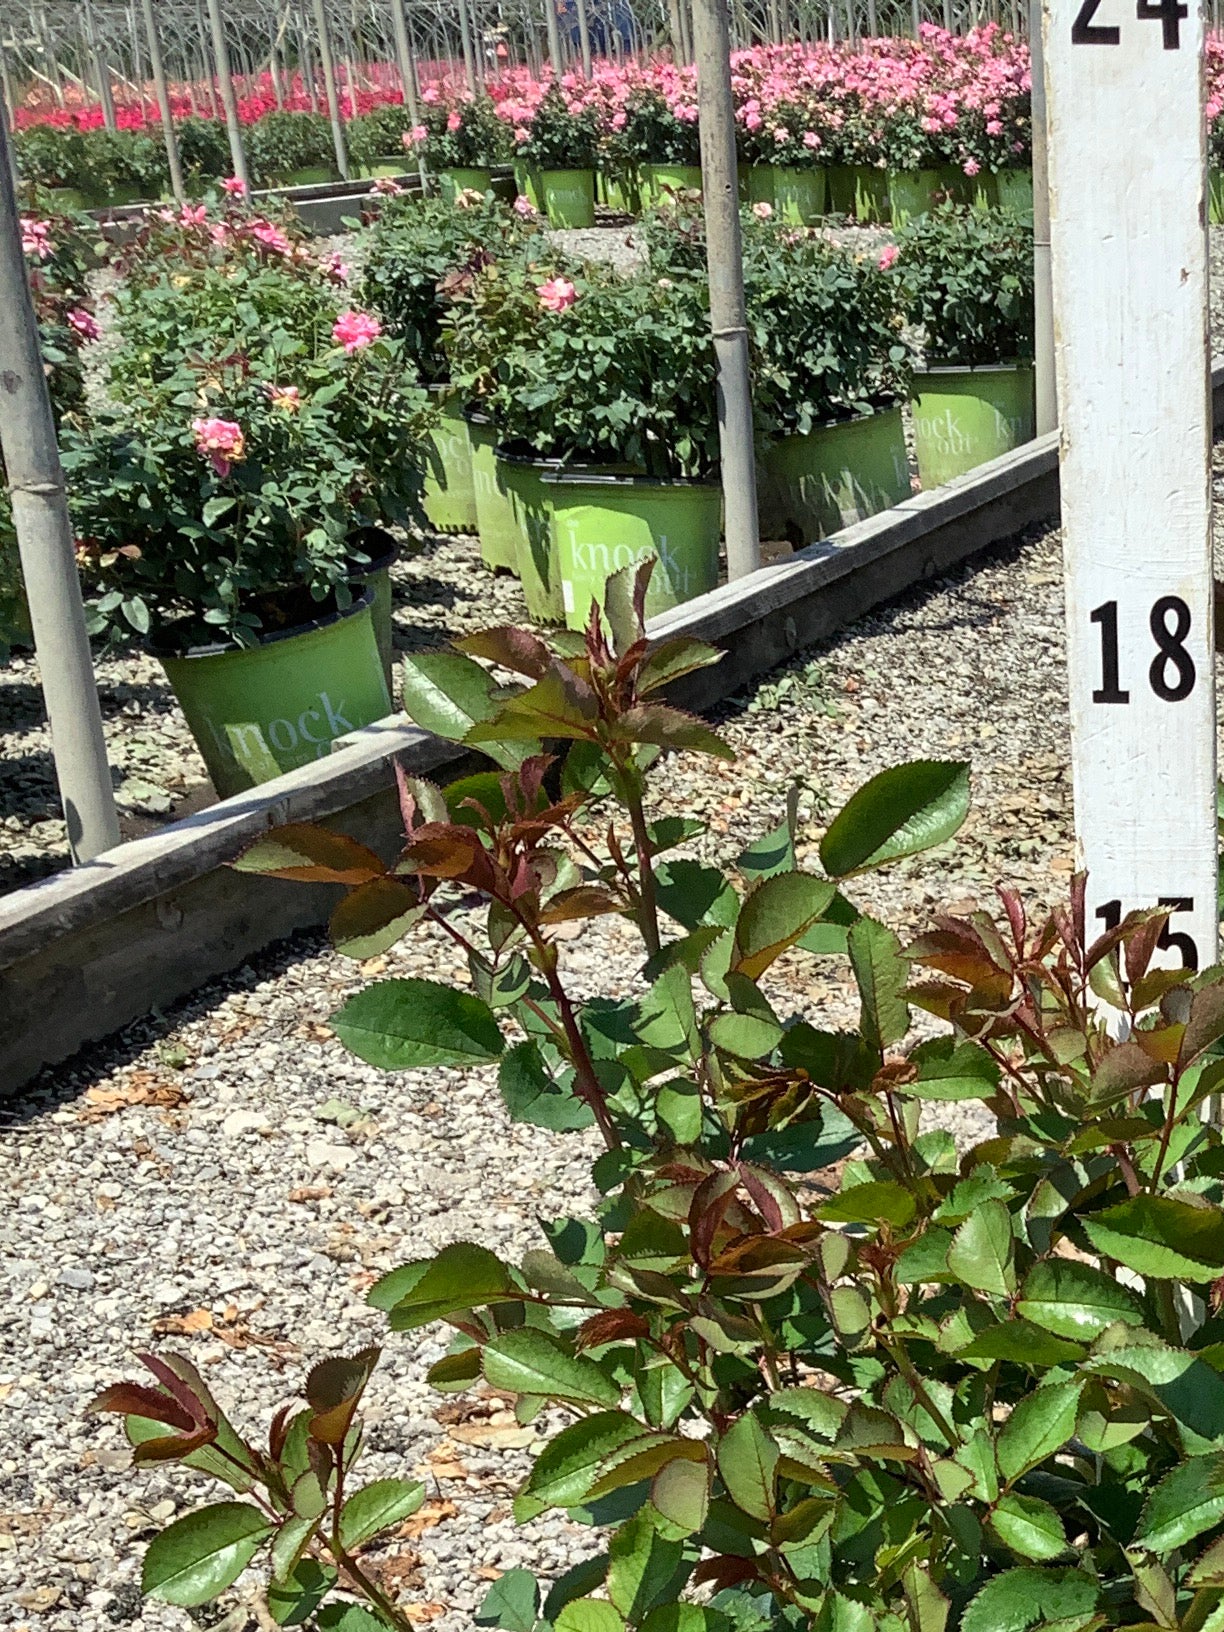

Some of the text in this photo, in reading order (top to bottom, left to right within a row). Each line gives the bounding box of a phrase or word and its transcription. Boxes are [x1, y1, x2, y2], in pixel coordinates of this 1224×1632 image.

[915, 409, 962, 439] ock
[1090, 596, 1196, 704] 18
[1095, 896, 1198, 993] 15
